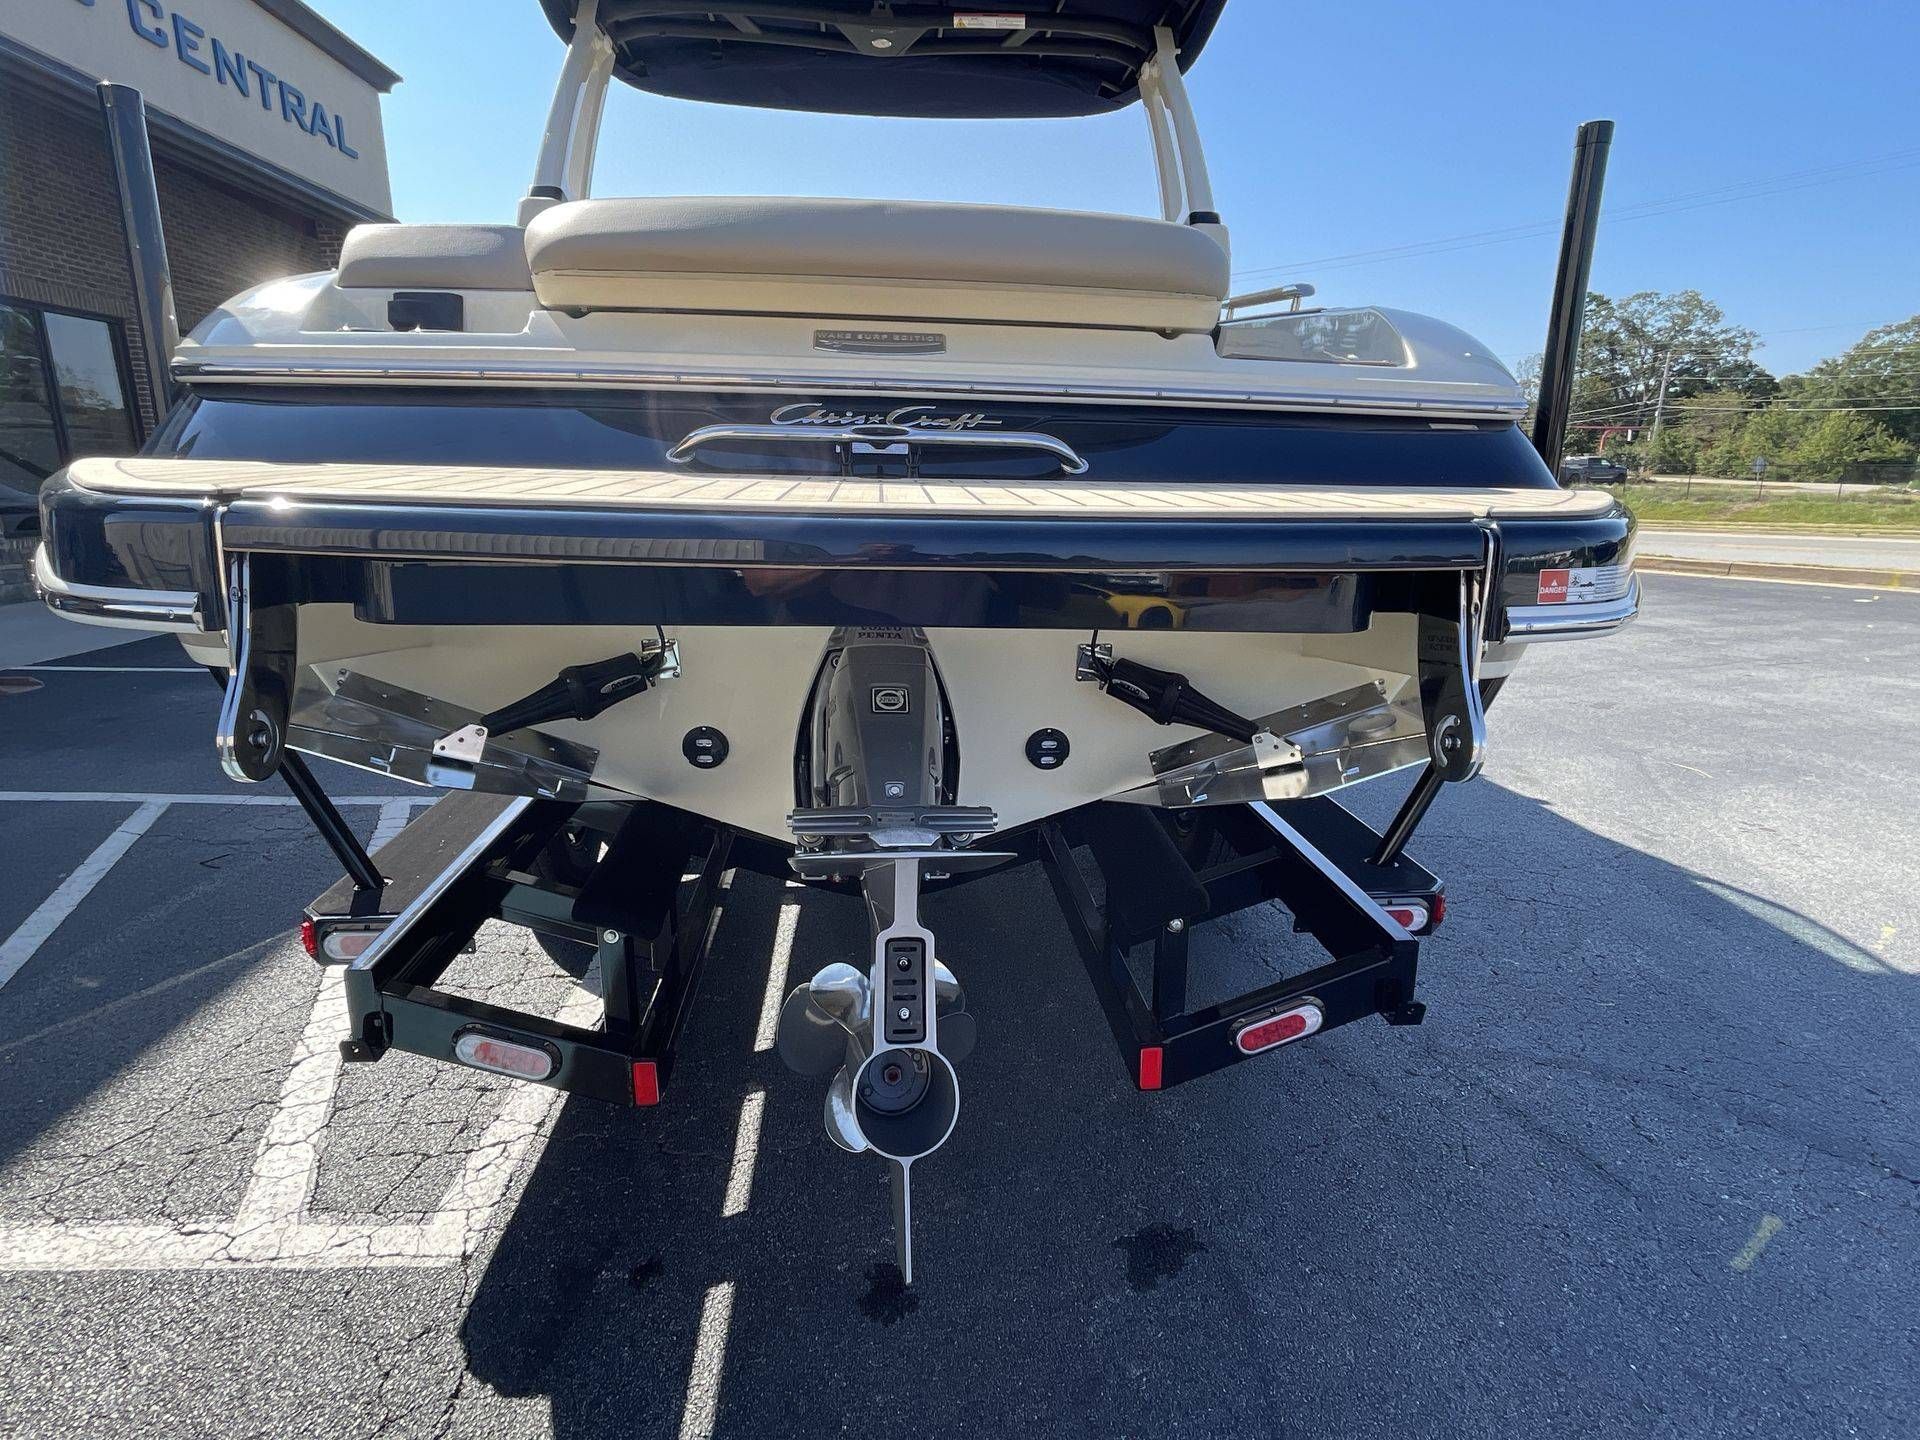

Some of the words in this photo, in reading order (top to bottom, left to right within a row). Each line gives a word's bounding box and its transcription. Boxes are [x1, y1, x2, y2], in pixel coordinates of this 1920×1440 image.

[126, 0, 359, 160] CENTRAL
[817, 332, 852, 340] WAKE
[770, 403, 867, 426] Chris
[886, 405, 1002, 431] Craft
[1540, 586, 1567, 594] DANGER
[857, 632, 903, 640] PENTA
